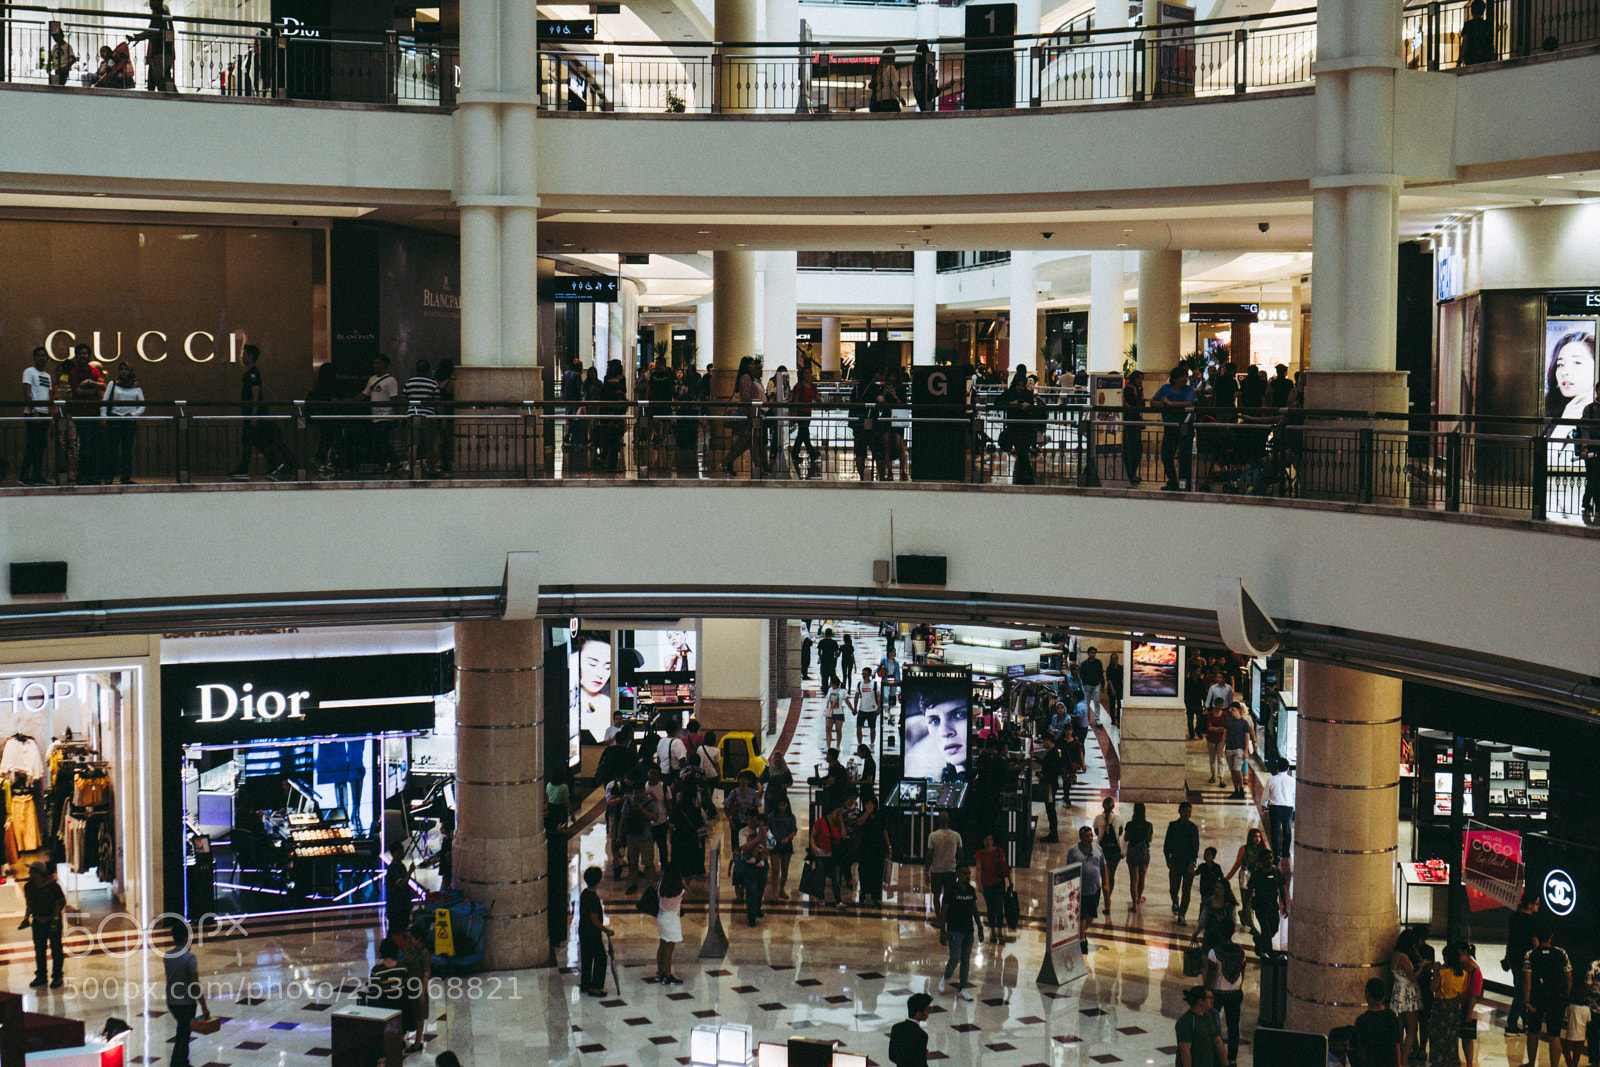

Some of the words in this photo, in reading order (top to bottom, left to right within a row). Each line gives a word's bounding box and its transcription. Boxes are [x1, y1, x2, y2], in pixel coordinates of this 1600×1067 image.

[281, 16, 320, 37] Dior
[984, 10, 995, 33] 1
[1249, 303, 1258, 313] G
[44, 329, 237, 363] GUCCI
[927, 371, 948, 396] G
[195, 682, 310, 723] Dior
[1472, 839, 1513, 857] COCO
